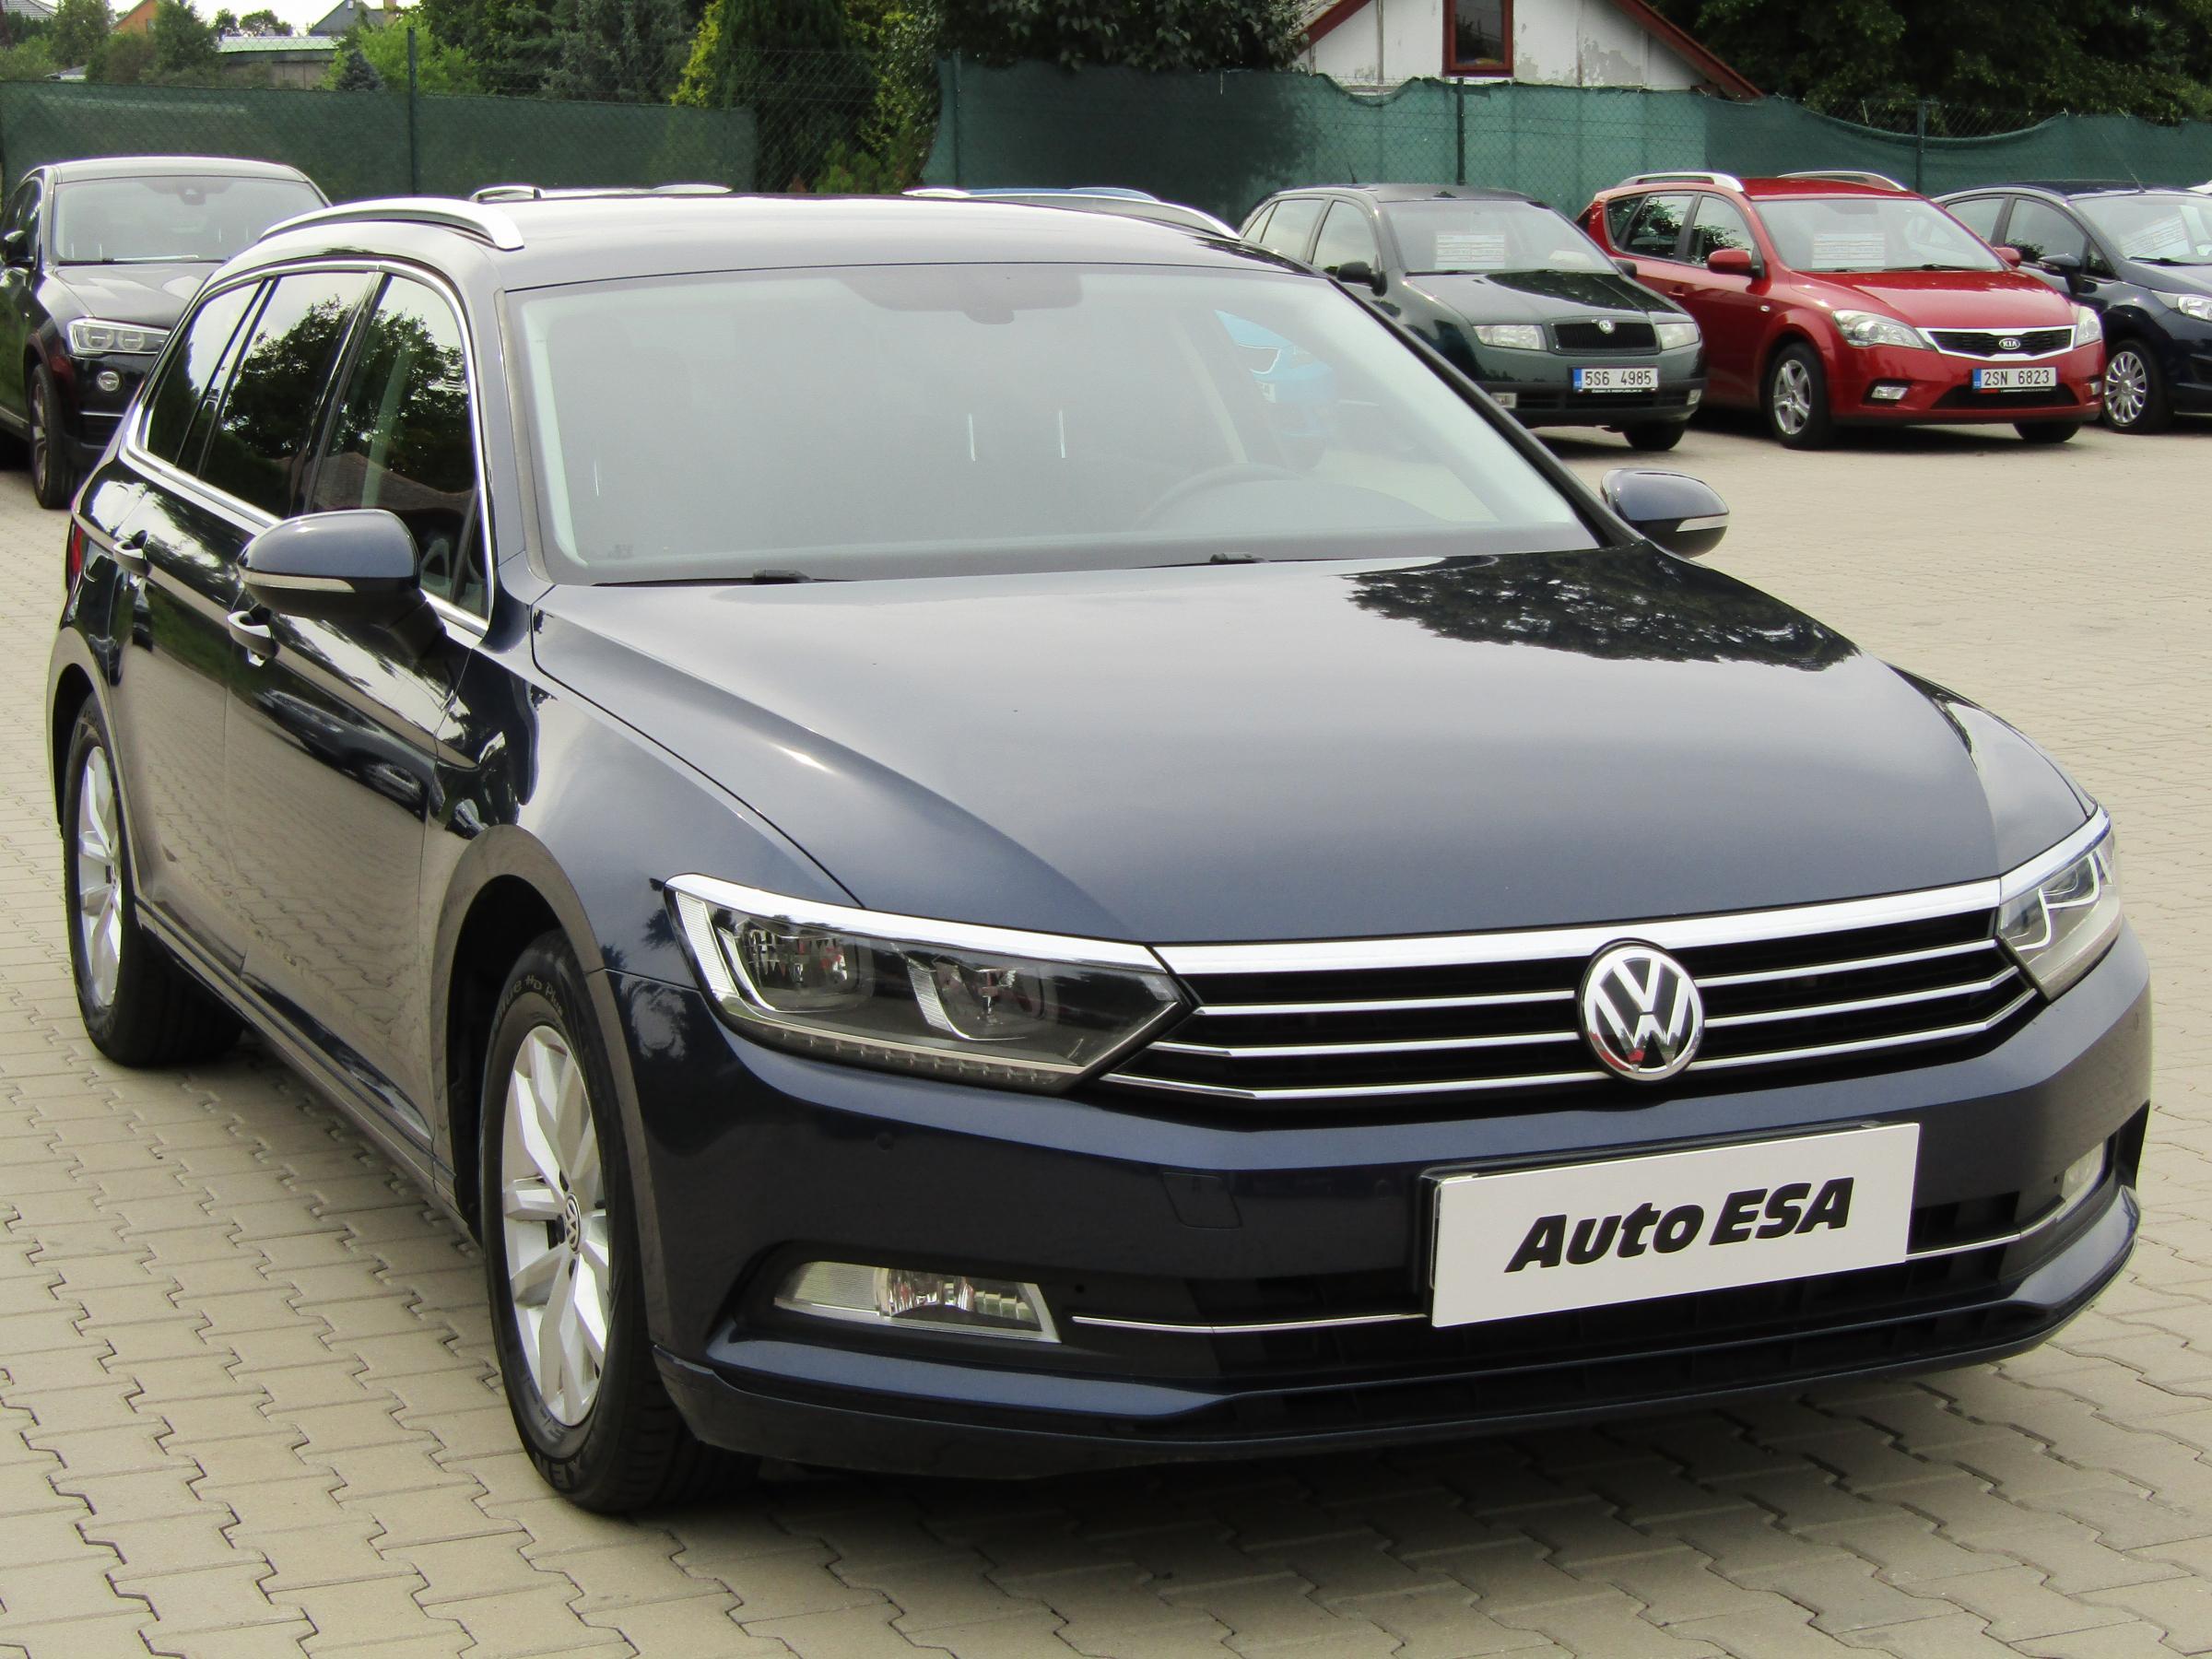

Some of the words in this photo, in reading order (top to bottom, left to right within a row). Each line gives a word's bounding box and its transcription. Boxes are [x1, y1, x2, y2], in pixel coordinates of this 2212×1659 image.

[1585, 371, 1610, 385] 5S6
[1620, 371, 1652, 385] 4985
[1984, 371, 2008, 385] 2SN
[2018, 371, 2050, 384] 6823
[1504, 1203, 1704, 1273] Auto
[1709, 1177, 1854, 1245] ESA
